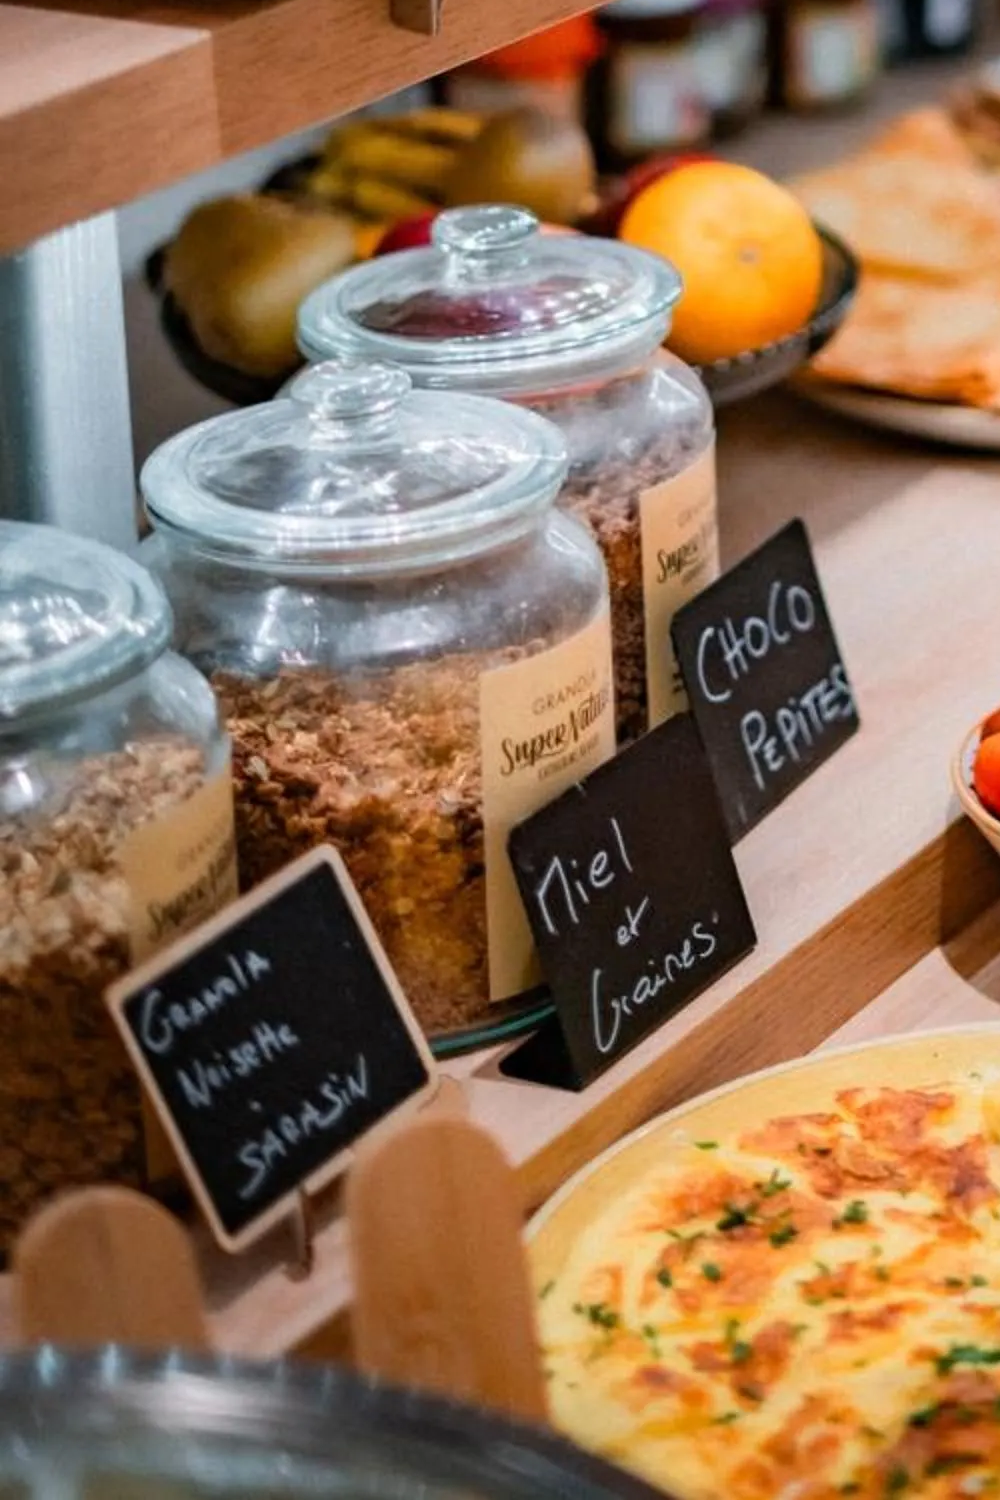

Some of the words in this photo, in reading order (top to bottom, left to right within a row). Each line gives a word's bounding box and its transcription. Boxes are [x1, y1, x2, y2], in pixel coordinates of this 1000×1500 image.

[697, 581, 815, 702] CHOCO
[537, 817, 633, 935] Miel
[616, 896, 649, 946] et
